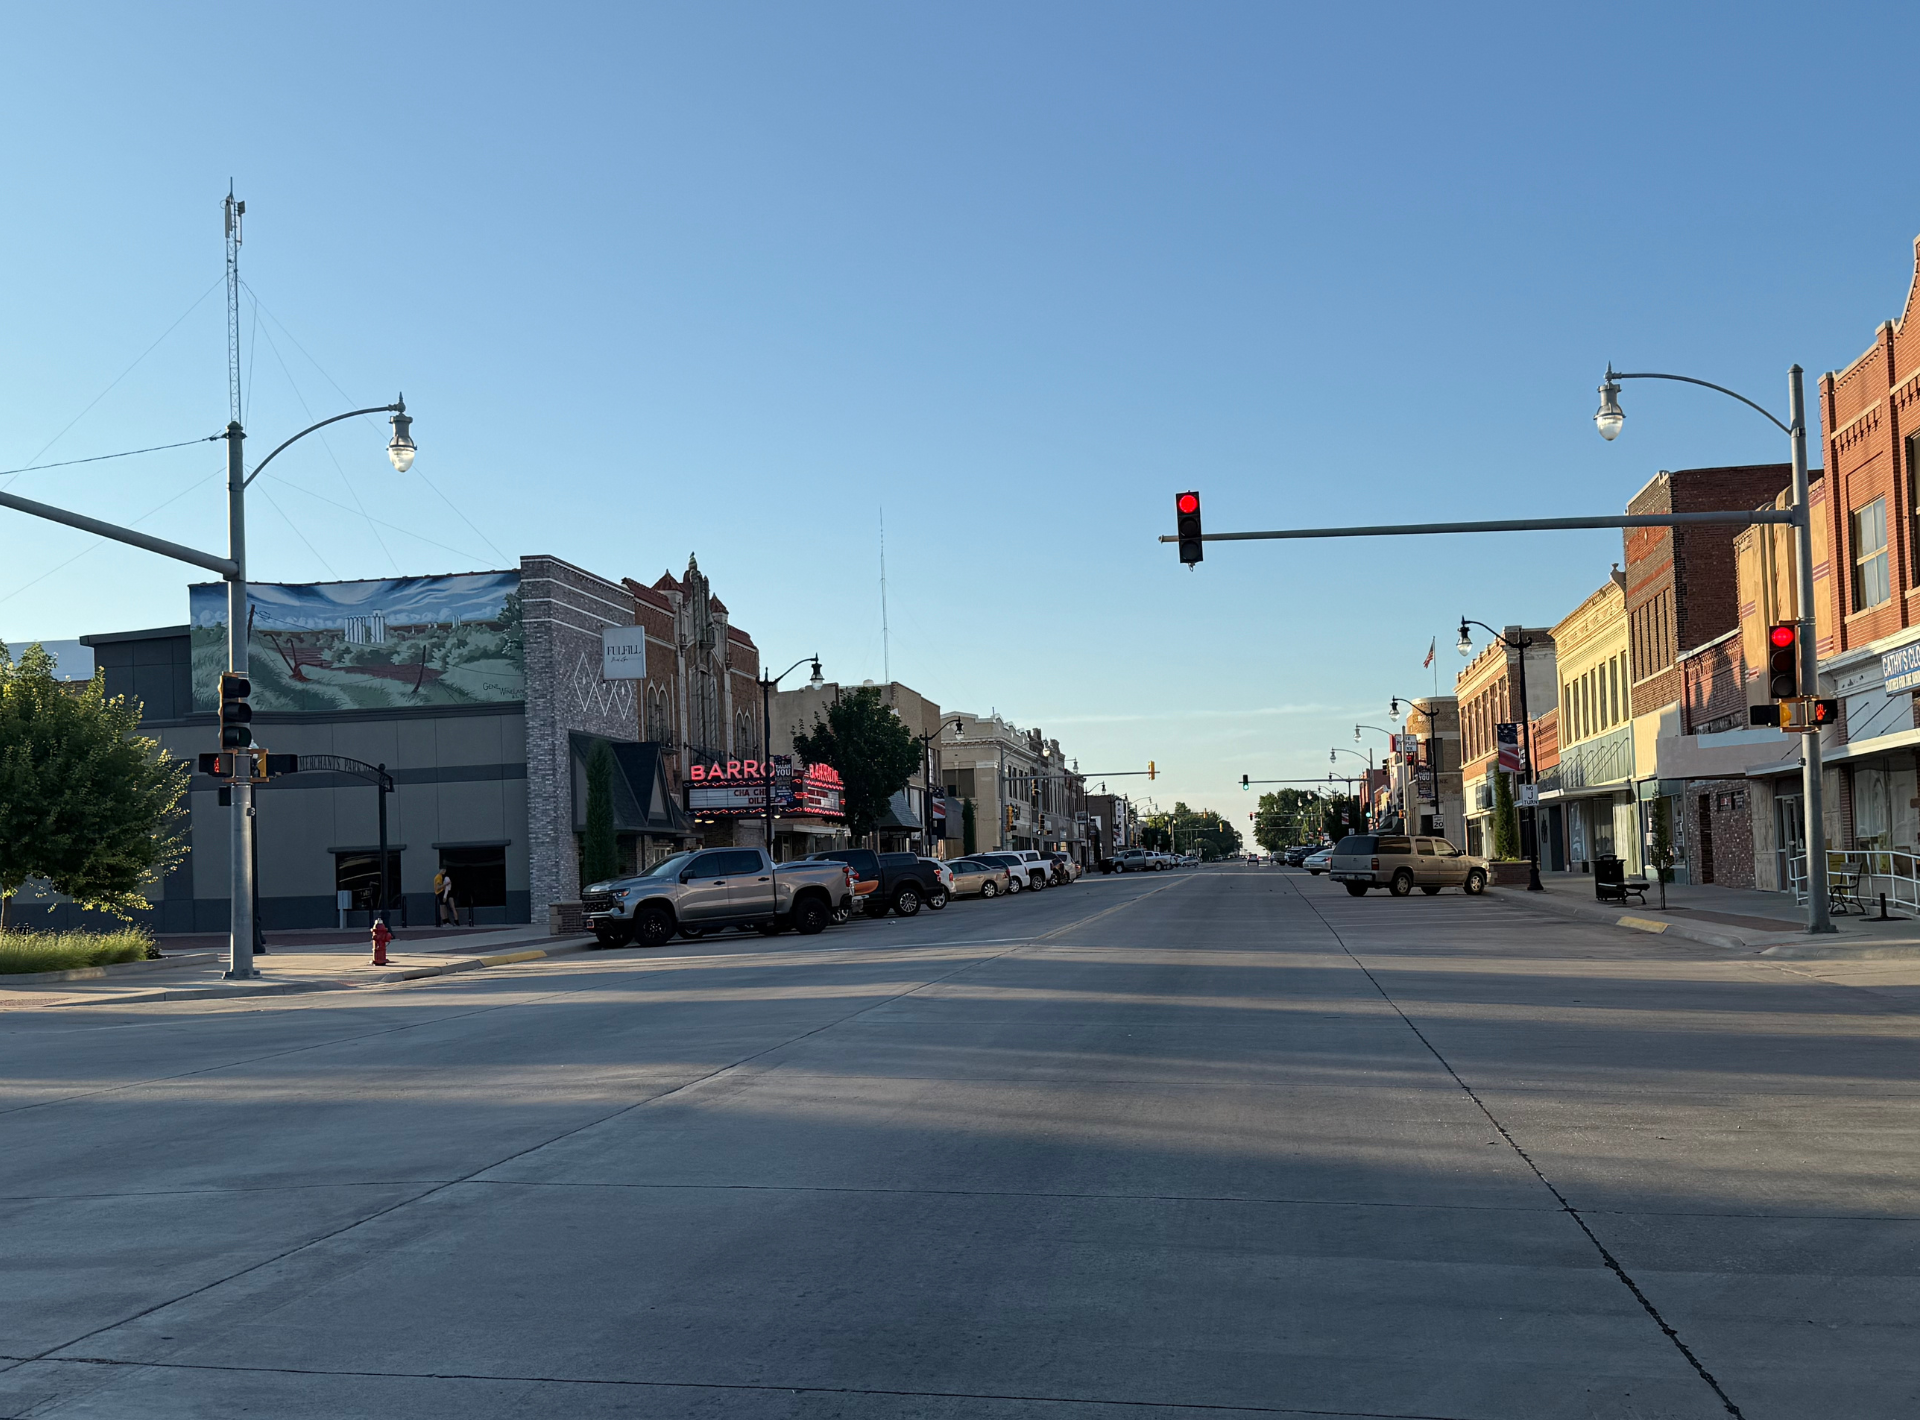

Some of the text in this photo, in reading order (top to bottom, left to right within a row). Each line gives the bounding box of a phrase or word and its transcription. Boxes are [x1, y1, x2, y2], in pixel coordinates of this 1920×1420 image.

[607, 645, 641, 655] FULFILL
[1882, 650, 1908, 677] CATHY'S
[299, 756, 340, 771] MERCHANTS
[1527, 792, 1534, 800] J
